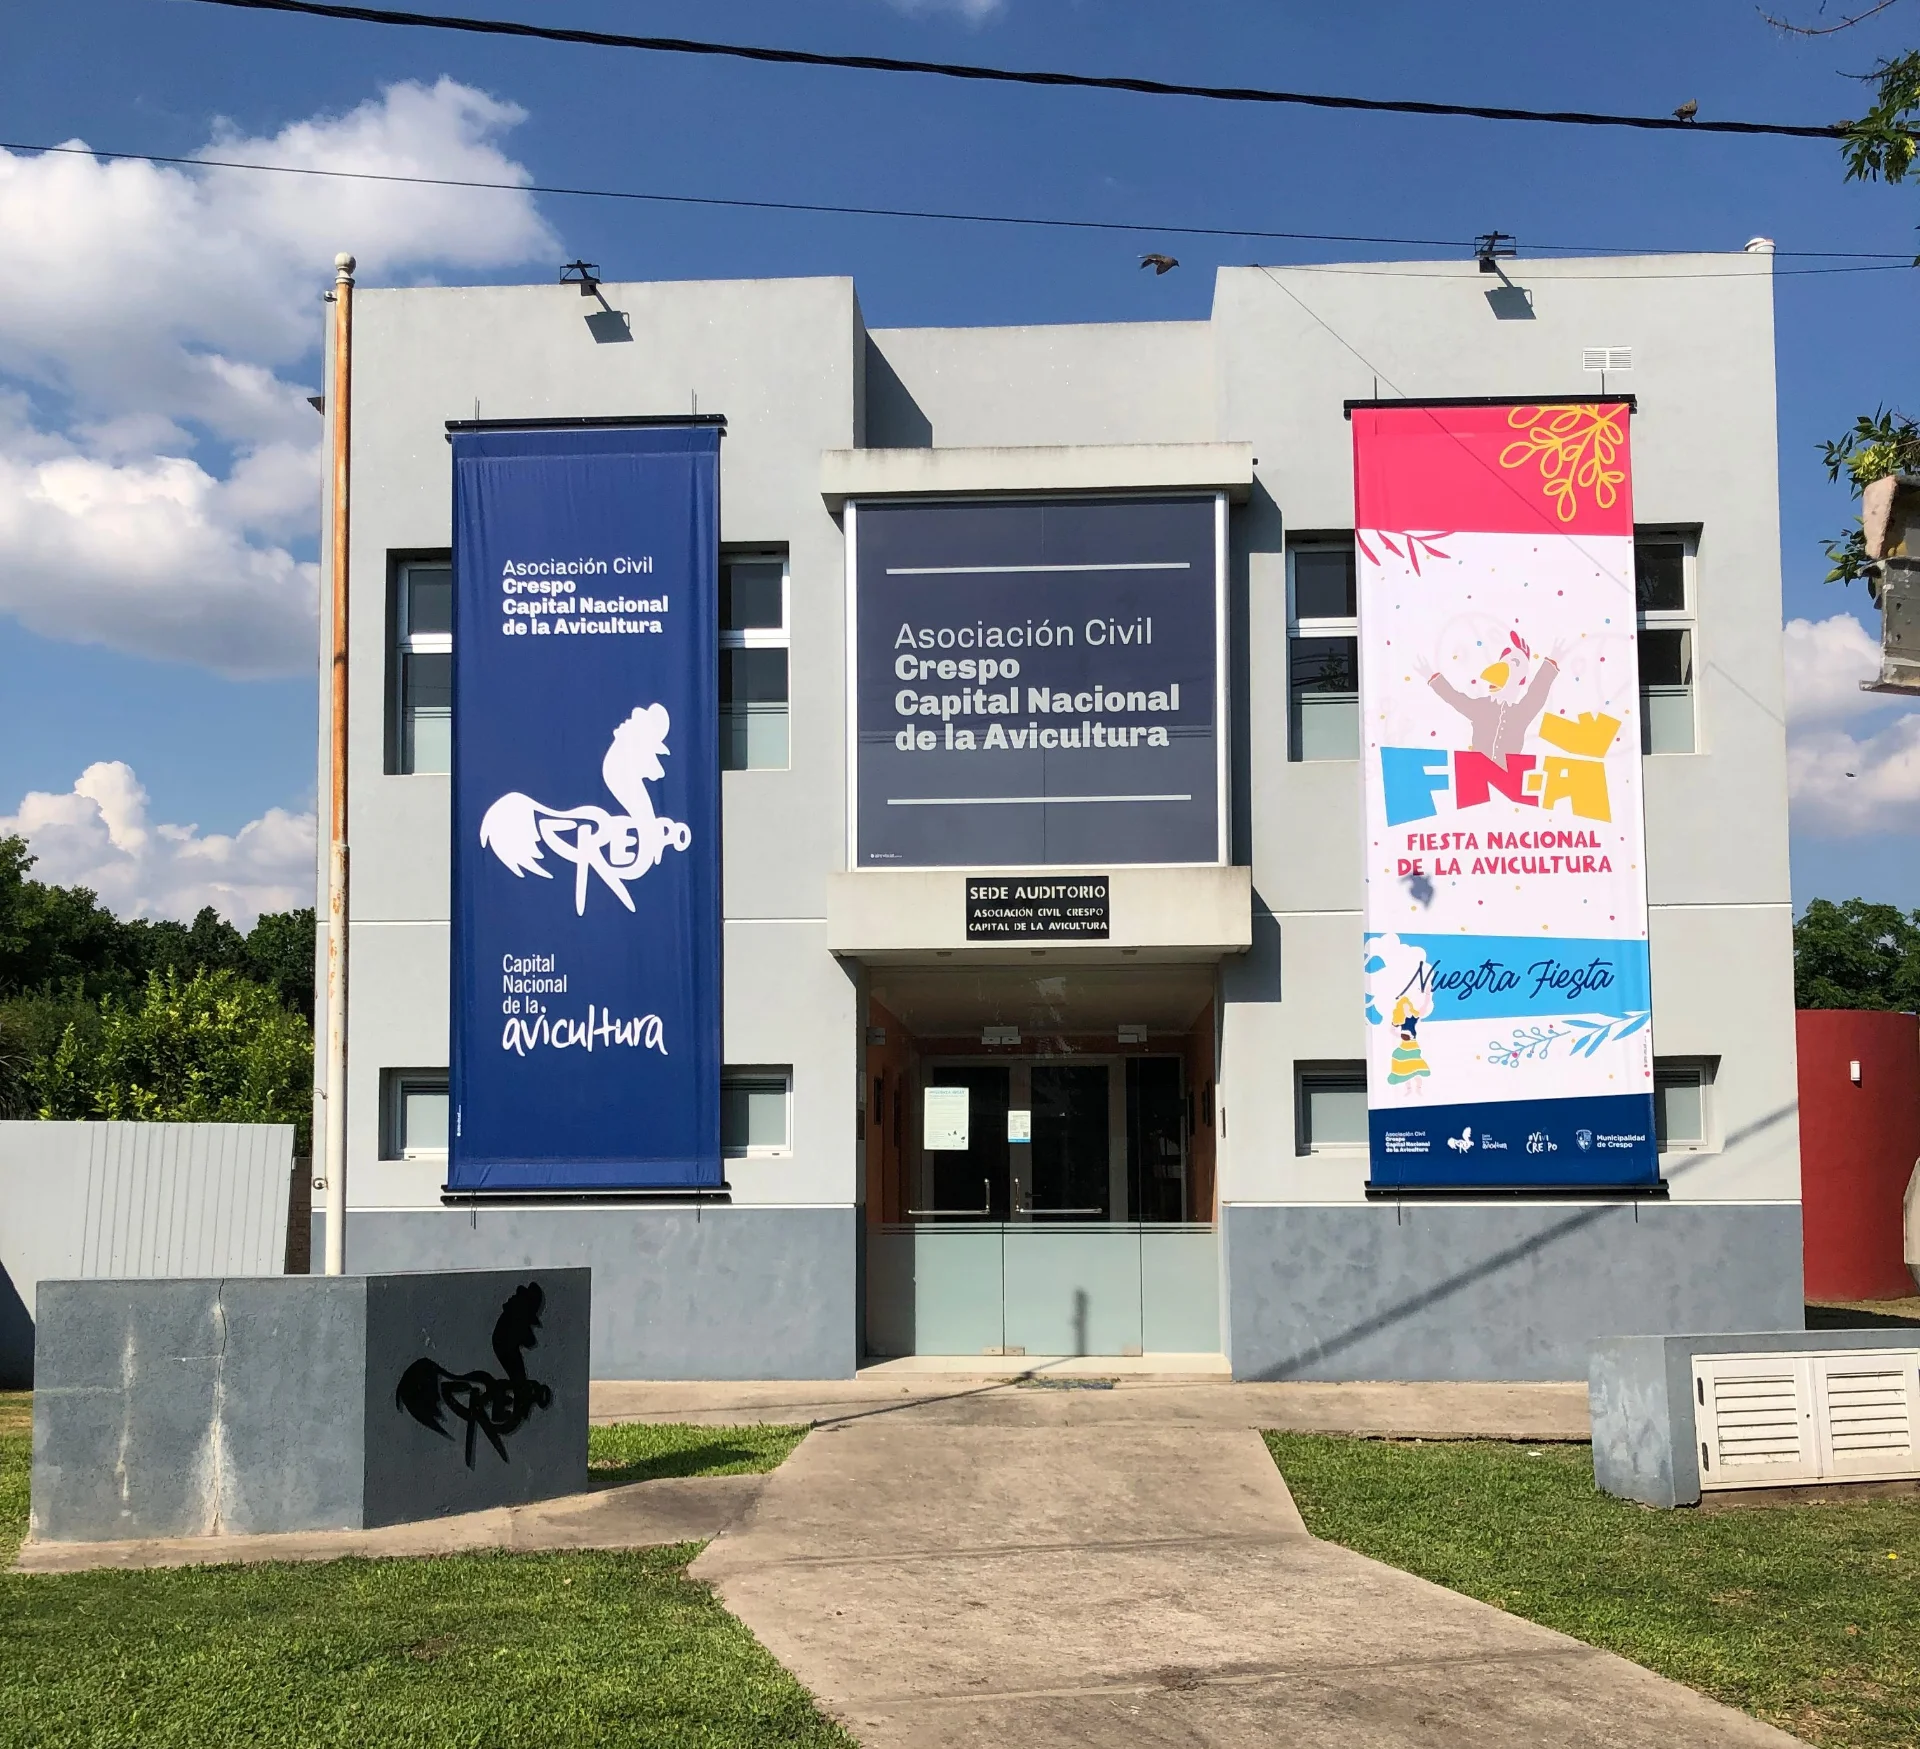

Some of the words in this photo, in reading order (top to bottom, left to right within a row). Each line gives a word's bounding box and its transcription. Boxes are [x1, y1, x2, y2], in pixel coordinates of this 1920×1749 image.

[503, 557, 607, 576] Asociación
[613, 556, 653, 574] Civil
[503, 578, 576, 597] Crespo
[503, 597, 575, 618] Capital
[579, 595, 669, 614] Nacional
[503, 618, 527, 635] de
[531, 618, 551, 635] la
[554, 616, 663, 635] Avicultura
[894, 619, 1074, 649] Asociación
[1085, 617, 1153, 646] Civil
[894, 654, 1020, 685] Crespo
[894, 686, 1019, 721] Capital
[1027, 683, 1180, 714] Nacional
[895, 723, 936, 751] de
[945, 723, 977, 751] la
[983, 720, 1170, 750] Avicultura
[1407, 832, 1479, 851] FIESTA
[1487, 830, 1602, 850] NACIONAL
[1398, 858, 1425, 877] DE
[1435, 857, 1462, 876] LA
[1471, 855, 1613, 875] AVICULTURA
[970, 886, 1009, 900] SEDE
[1015, 885, 1106, 900] AUDITORIO
[973, 907, 1033, 918] ASOCIACIÓN
[1037, 907, 1061, 917] CIVIL
[1066, 907, 1104, 917] CRESPO
[969, 922, 1010, 932] CAPITAL
[1014, 922, 1027, 931] DE
[1030, 922, 1044, 931] LA
[1048, 921, 1108, 931] AVICULTURA
[503, 953, 555, 976] Capital
[503, 974, 567, 993] Nacional
[1395, 958, 1521, 1001] Nuestra
[1527, 957, 1615, 1000] Fiesta
[503, 995, 520, 1014] de
[525, 995, 538, 1014] la
[502, 1004, 669, 1057] avicultura
[1597, 1134, 1646, 1142] Municipalidad
[1608, 1141, 1633, 1149] Crespo
